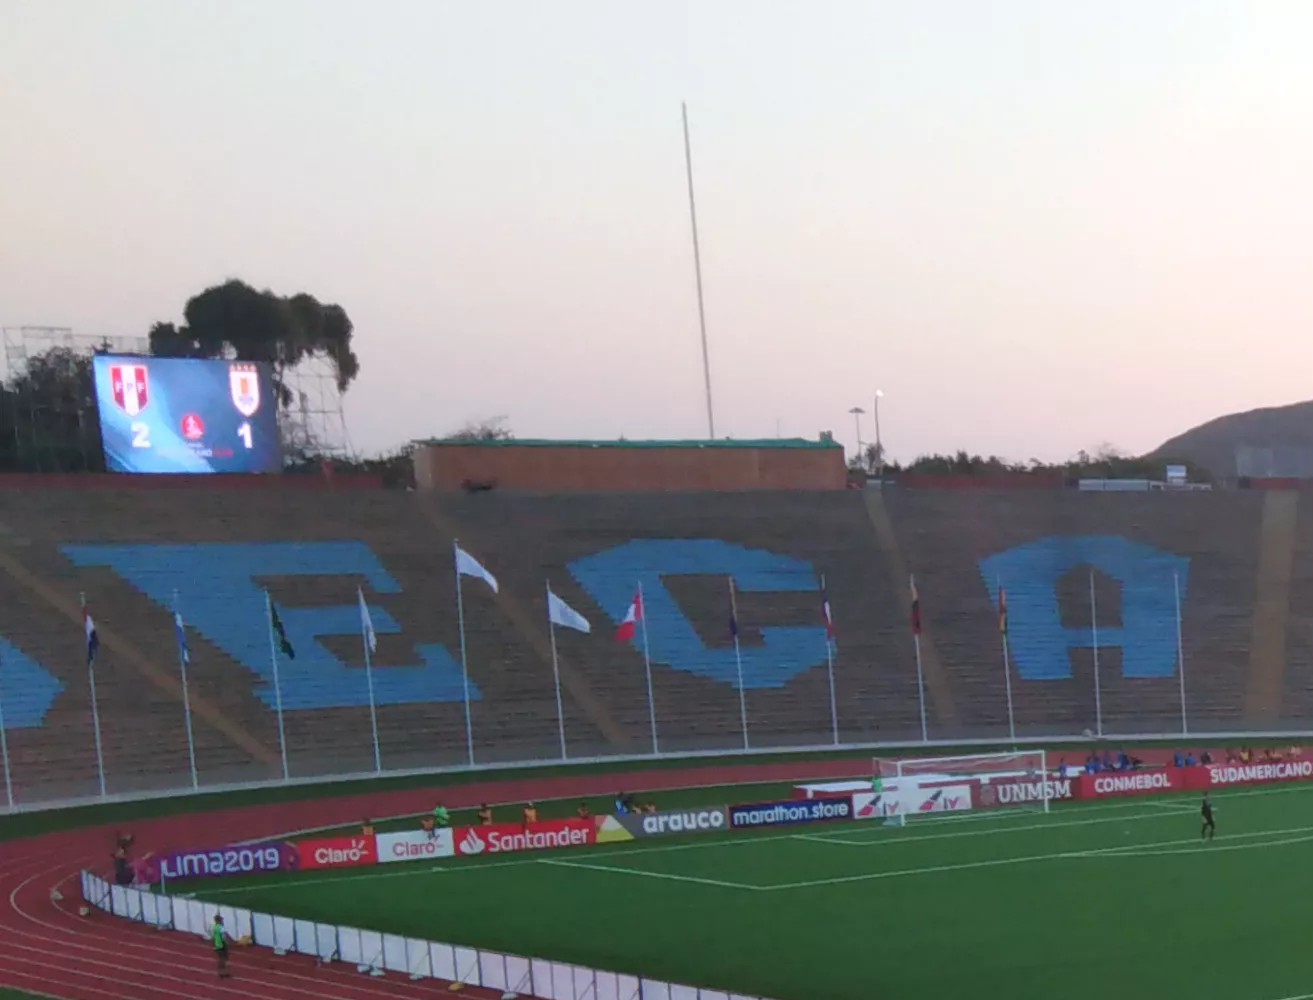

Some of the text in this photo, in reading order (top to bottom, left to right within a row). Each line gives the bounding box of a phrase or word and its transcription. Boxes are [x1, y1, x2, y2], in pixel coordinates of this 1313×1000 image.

[131, 421, 151, 449] 2
[237, 421, 253, 449] 1
[996, 779, 1073, 804] UNMSM
[1094, 771, 1171, 794] CONMEBOL
[642, 809, 725, 834] arauco
[733, 801, 849, 826] marathon.store
[392, 840, 438, 857] Claro
[487, 825, 590, 853] Santander
[314, 845, 363, 864] Claro
